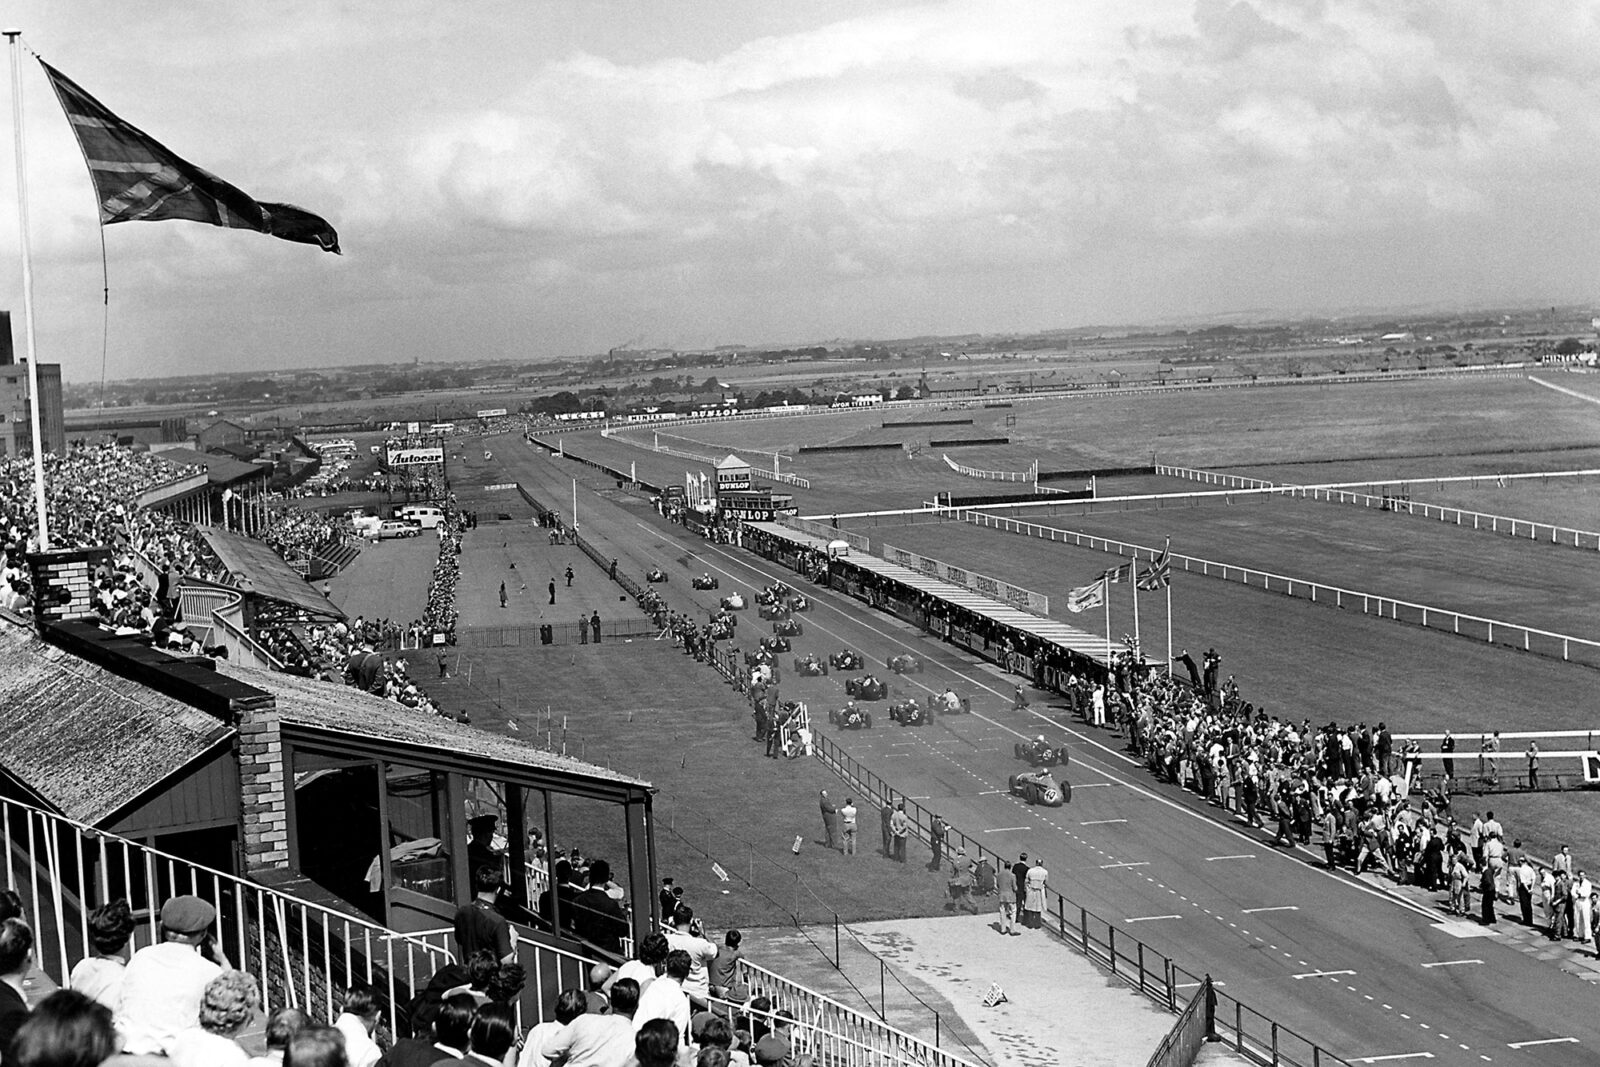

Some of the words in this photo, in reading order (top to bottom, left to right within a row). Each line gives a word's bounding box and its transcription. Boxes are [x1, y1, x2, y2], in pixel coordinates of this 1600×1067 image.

[691, 408, 737, 418] DUNLOP
[390, 453, 442, 464] Autocar
[719, 482, 749, 490] DUNLOP
